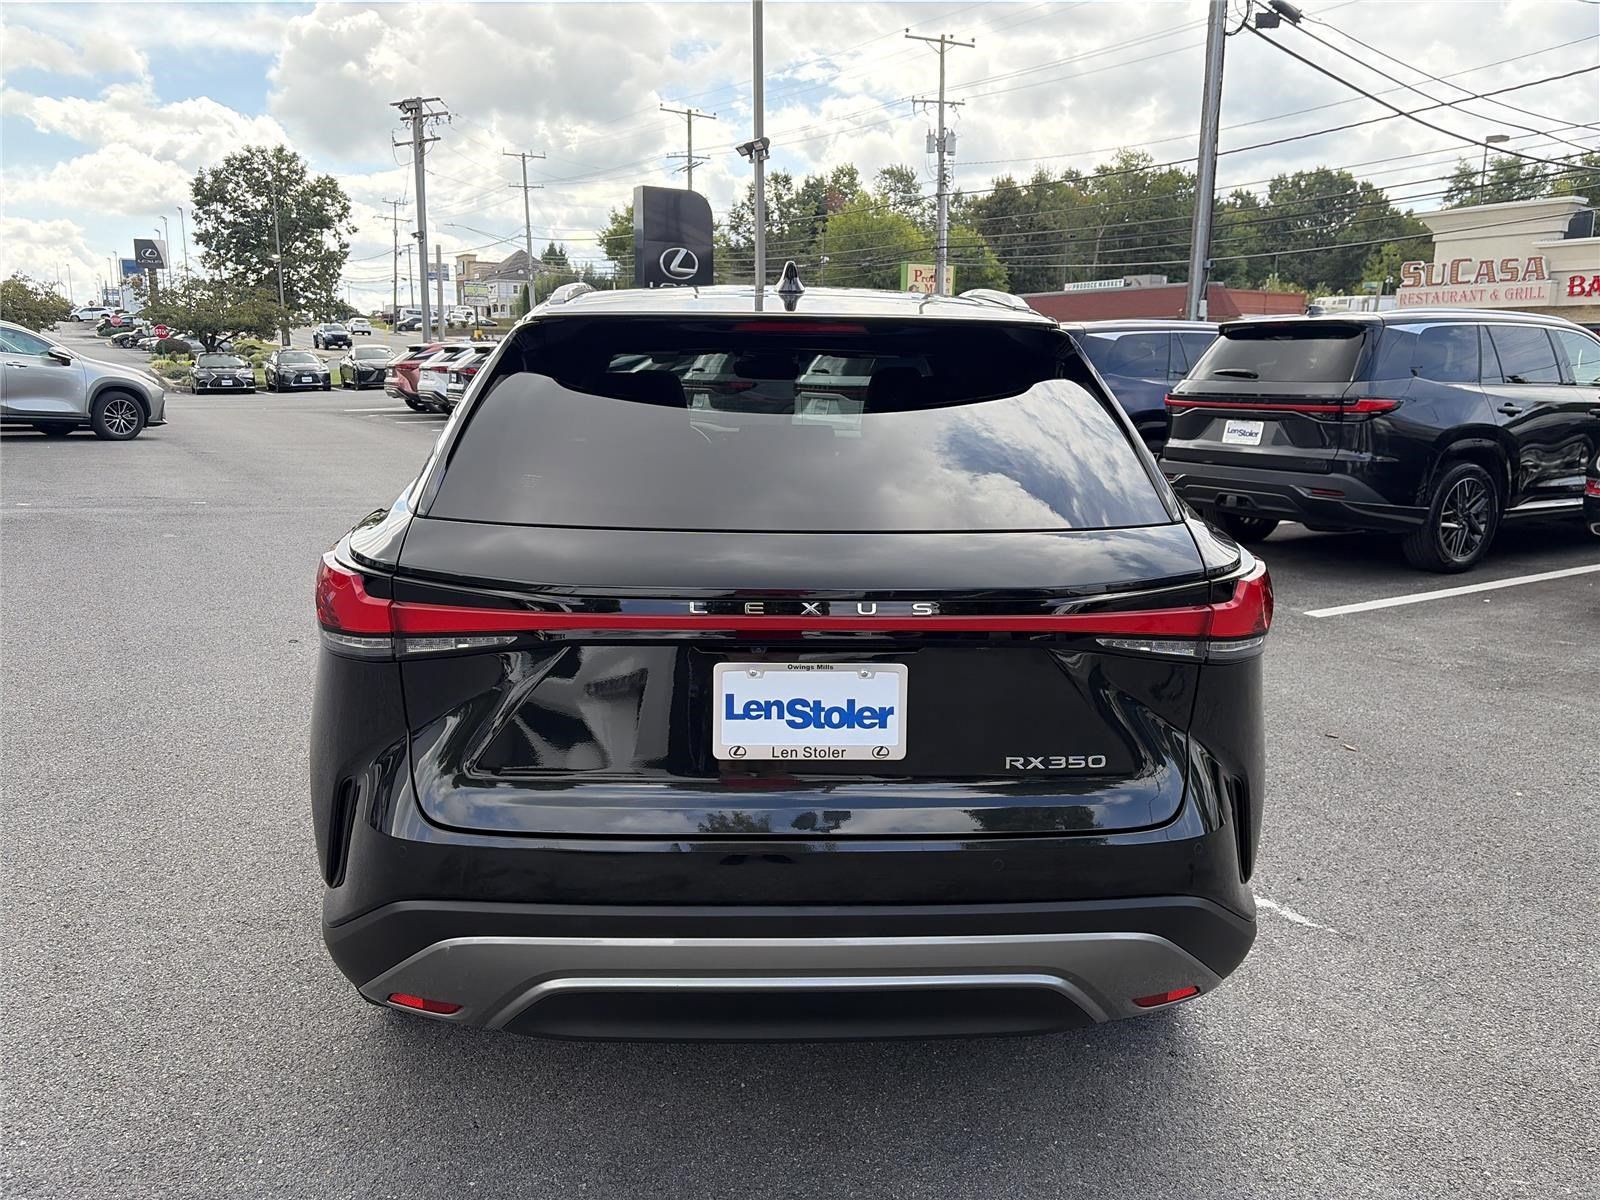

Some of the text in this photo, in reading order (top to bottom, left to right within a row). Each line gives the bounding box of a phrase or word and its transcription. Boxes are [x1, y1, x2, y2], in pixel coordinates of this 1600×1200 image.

[1098, 280, 1123, 288] MARKET
[1400, 286, 1545, 305] RESTAURANT & GRILL
[689, 602, 932, 615] LEXUS
[771, 746, 847, 759] Len Stoler
